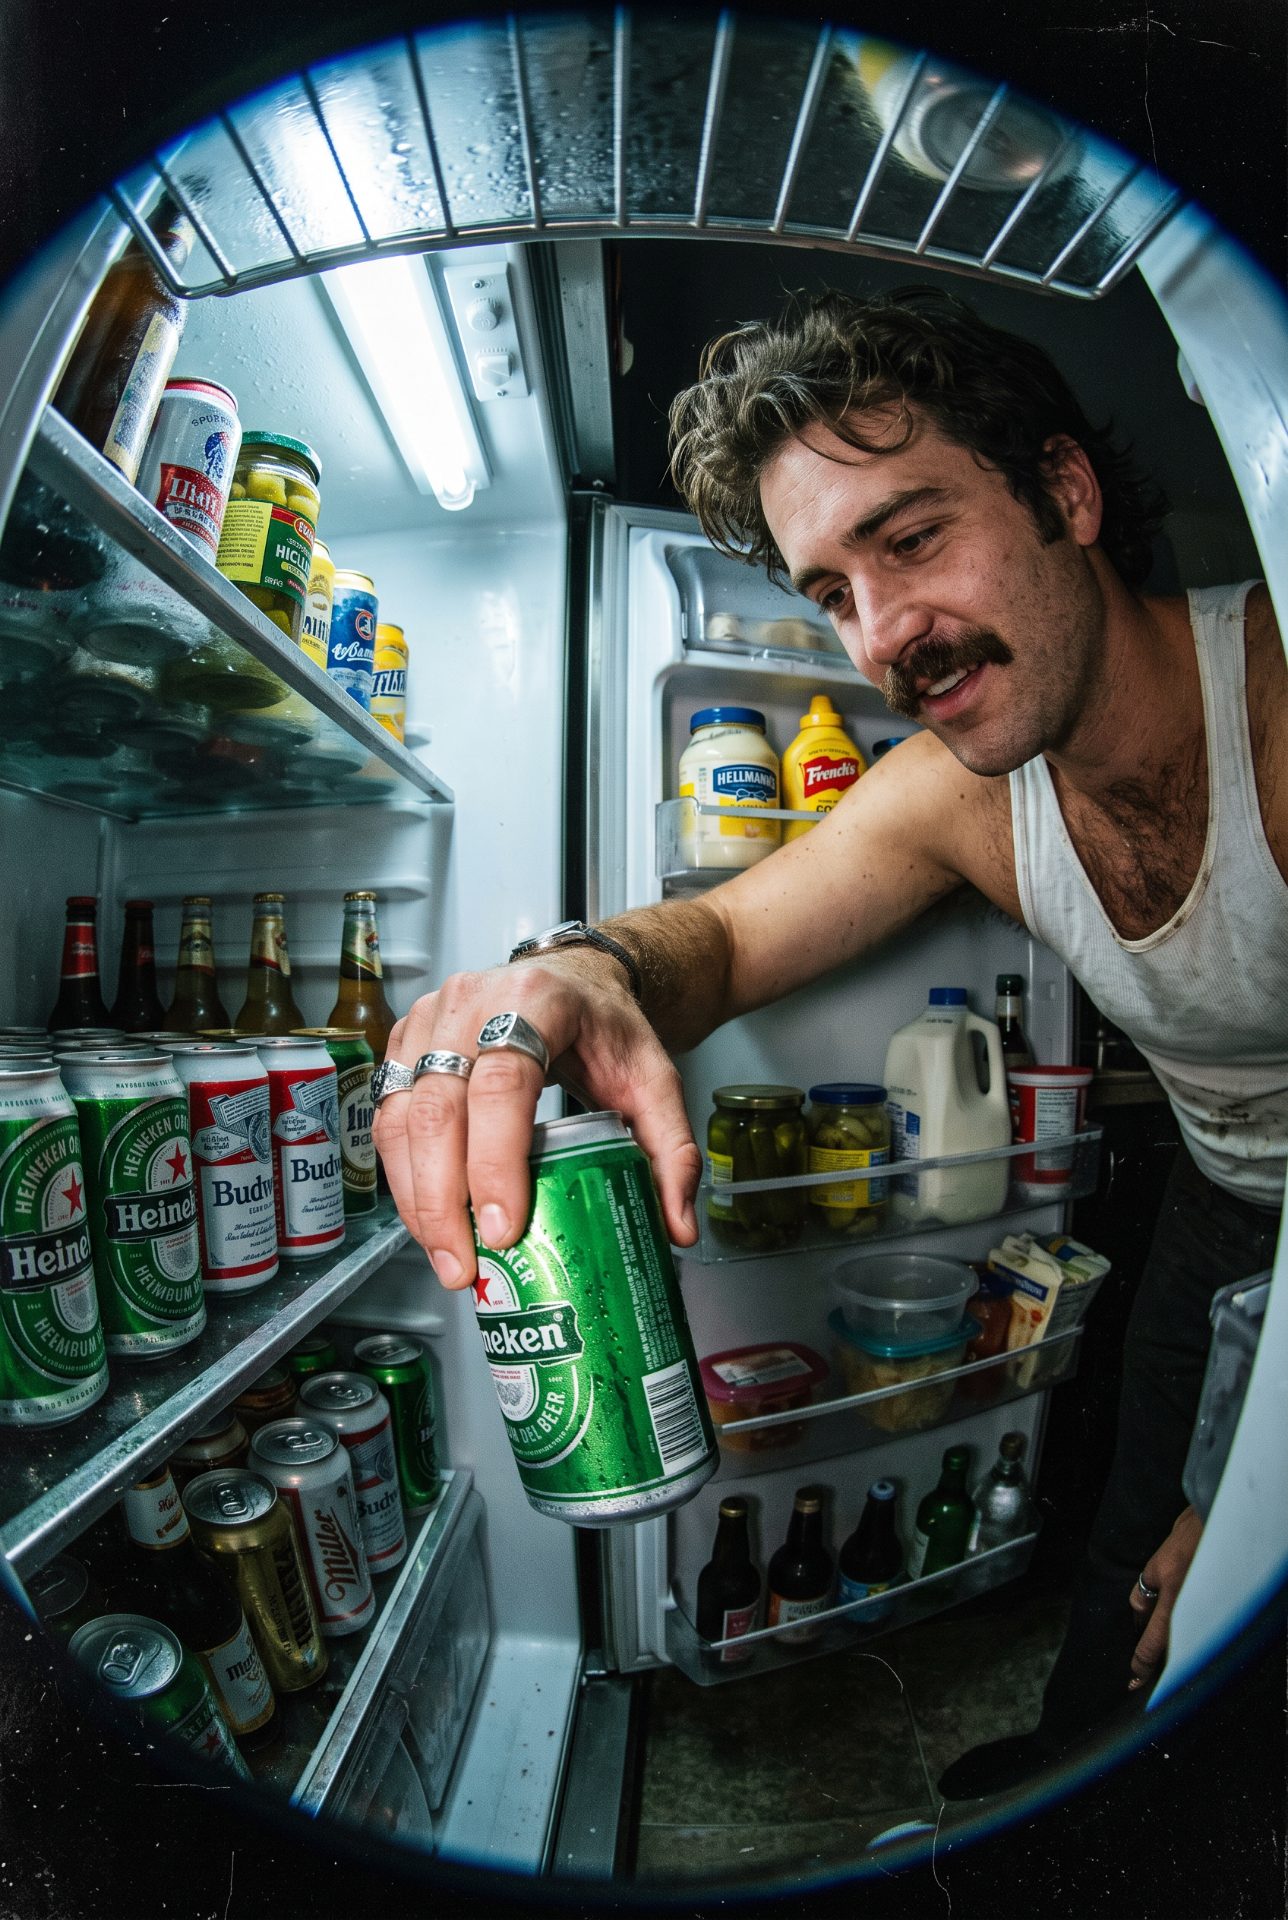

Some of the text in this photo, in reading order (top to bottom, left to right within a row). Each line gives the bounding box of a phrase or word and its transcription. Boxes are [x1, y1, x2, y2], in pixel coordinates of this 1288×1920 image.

[806, 762, 856, 786] French's
[15, 1138, 67, 1215] HEINEKEN
[123, 1116, 172, 1178] HEINEKEN
[313, 1507, 358, 1602] Miller
